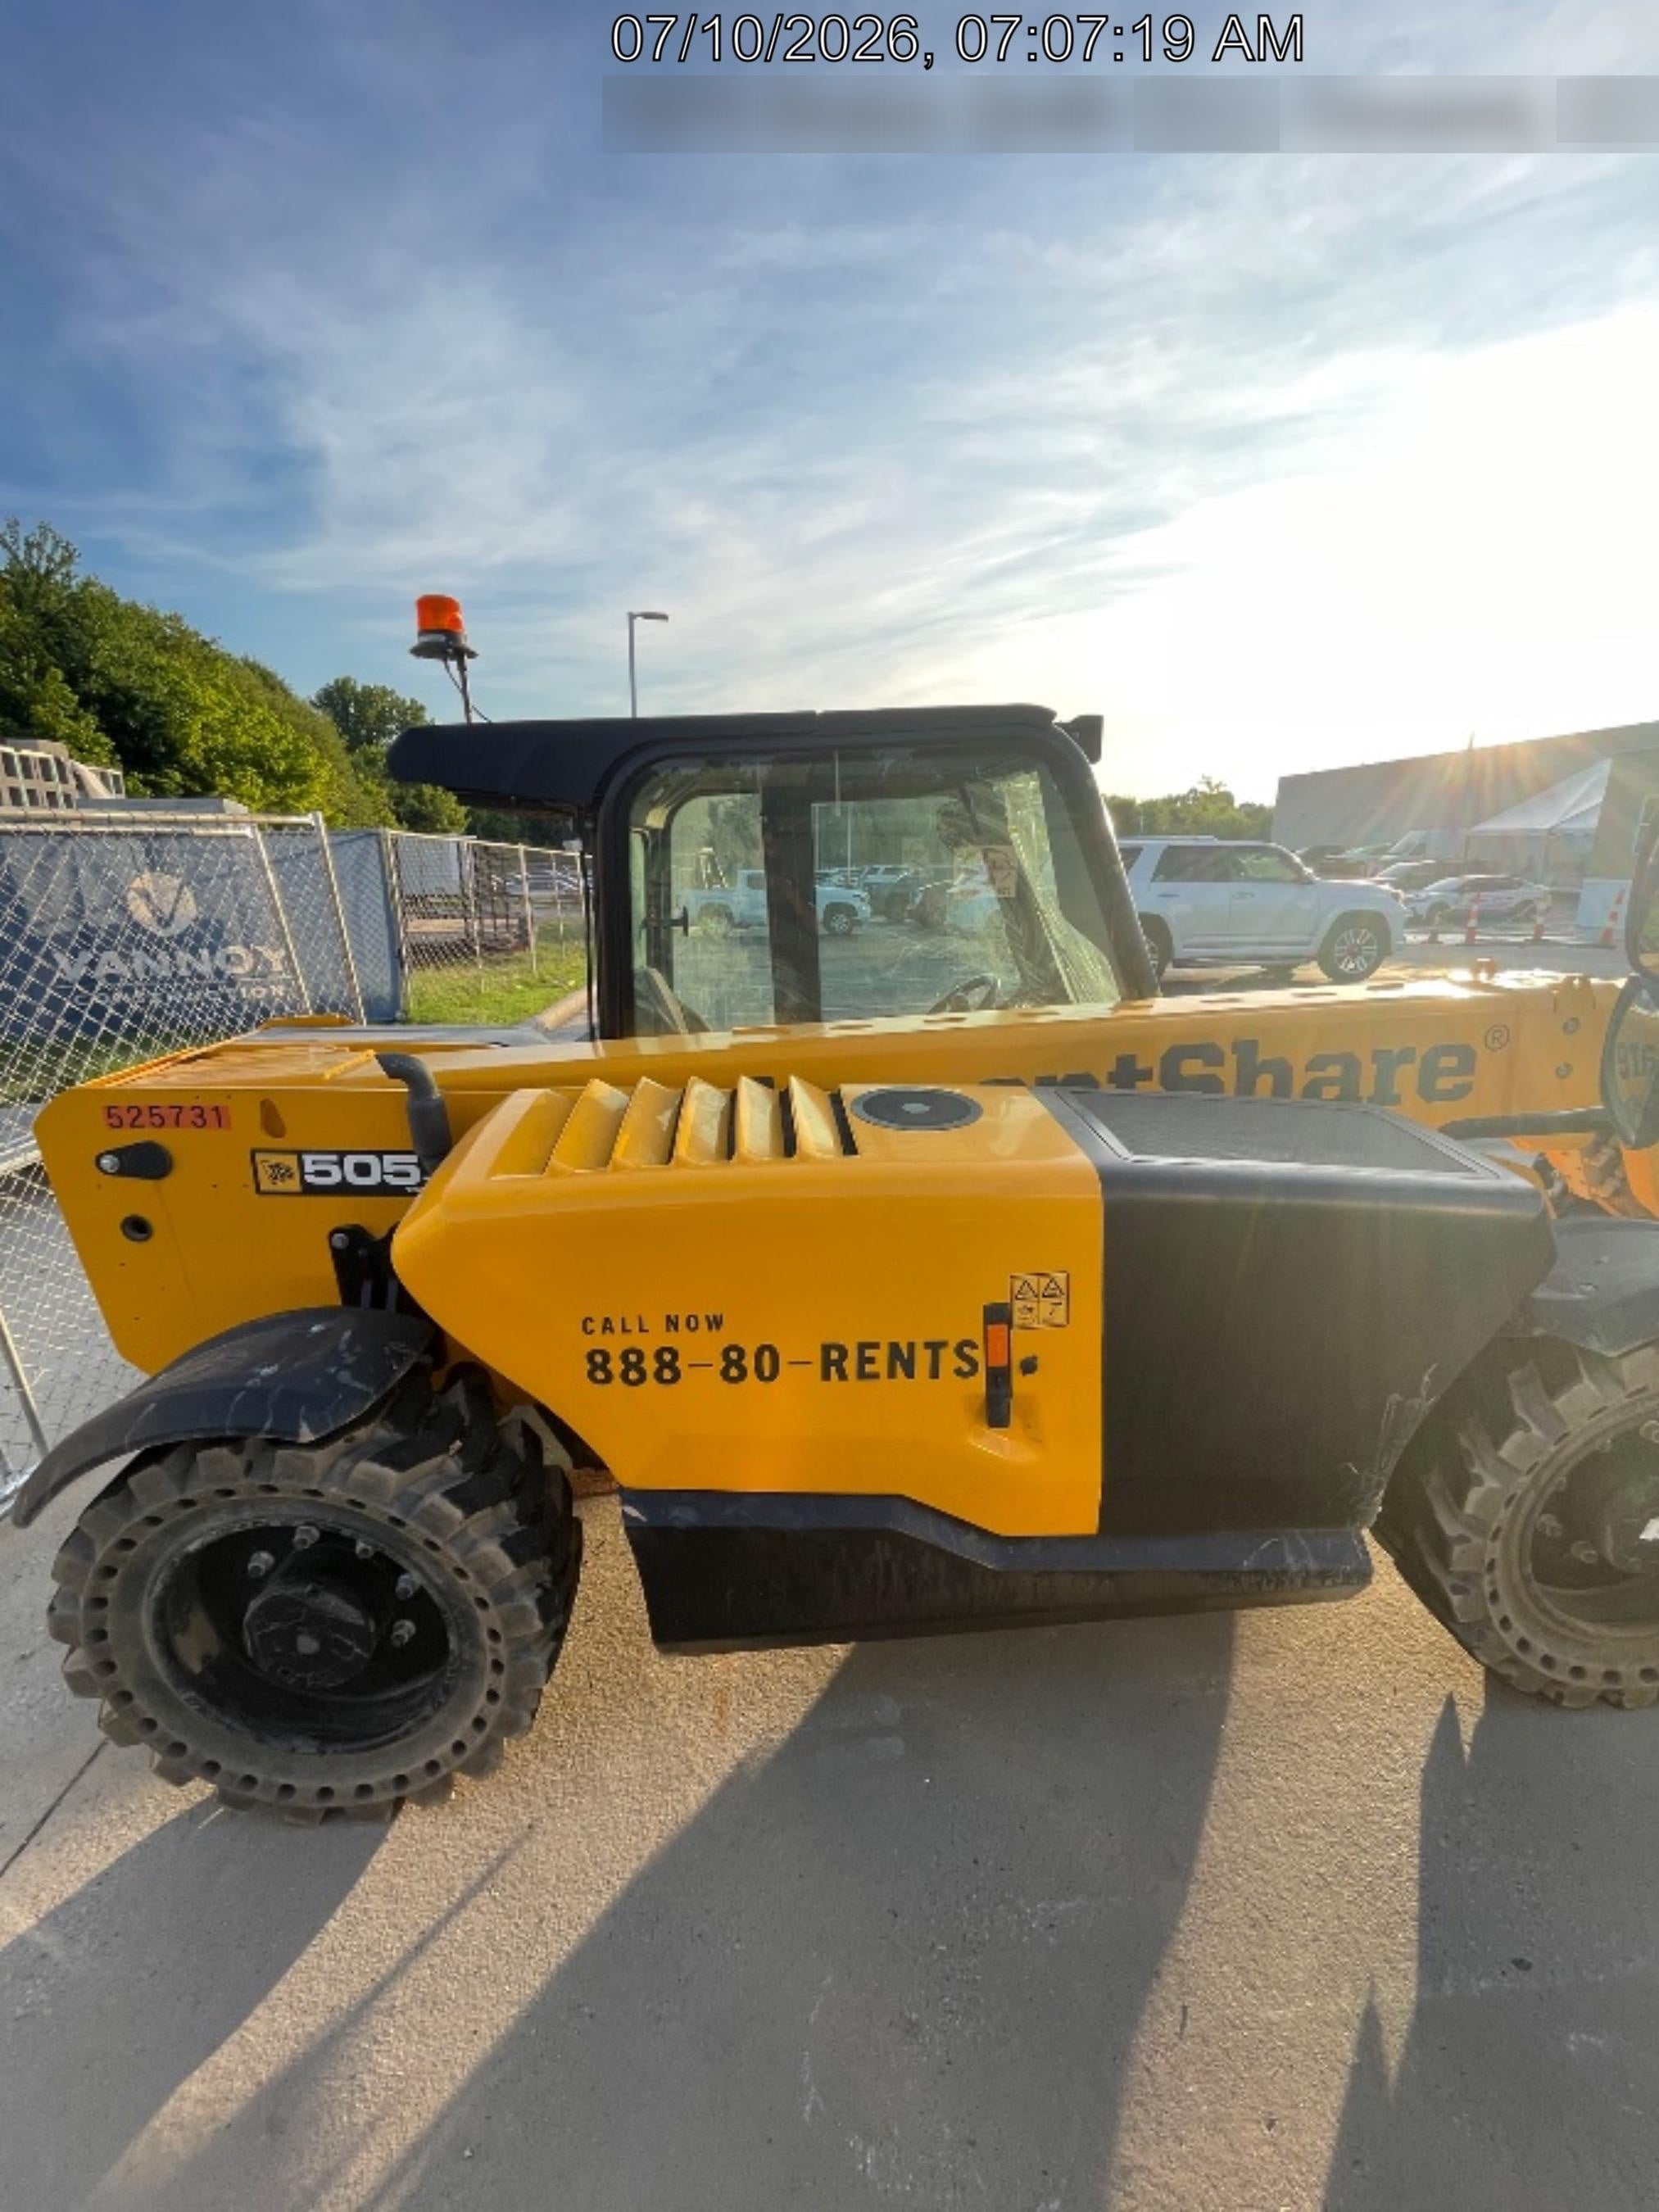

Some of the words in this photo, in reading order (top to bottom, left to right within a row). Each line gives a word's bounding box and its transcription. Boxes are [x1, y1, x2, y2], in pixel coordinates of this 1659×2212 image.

[52, 945, 286, 980] VANNOY
[74, 985, 286, 1007] CONUCION
[107, 1105, 223, 1129] 525731
[582, 1315, 650, 1335] CALL
[664, 1313, 724, 1333] NOW
